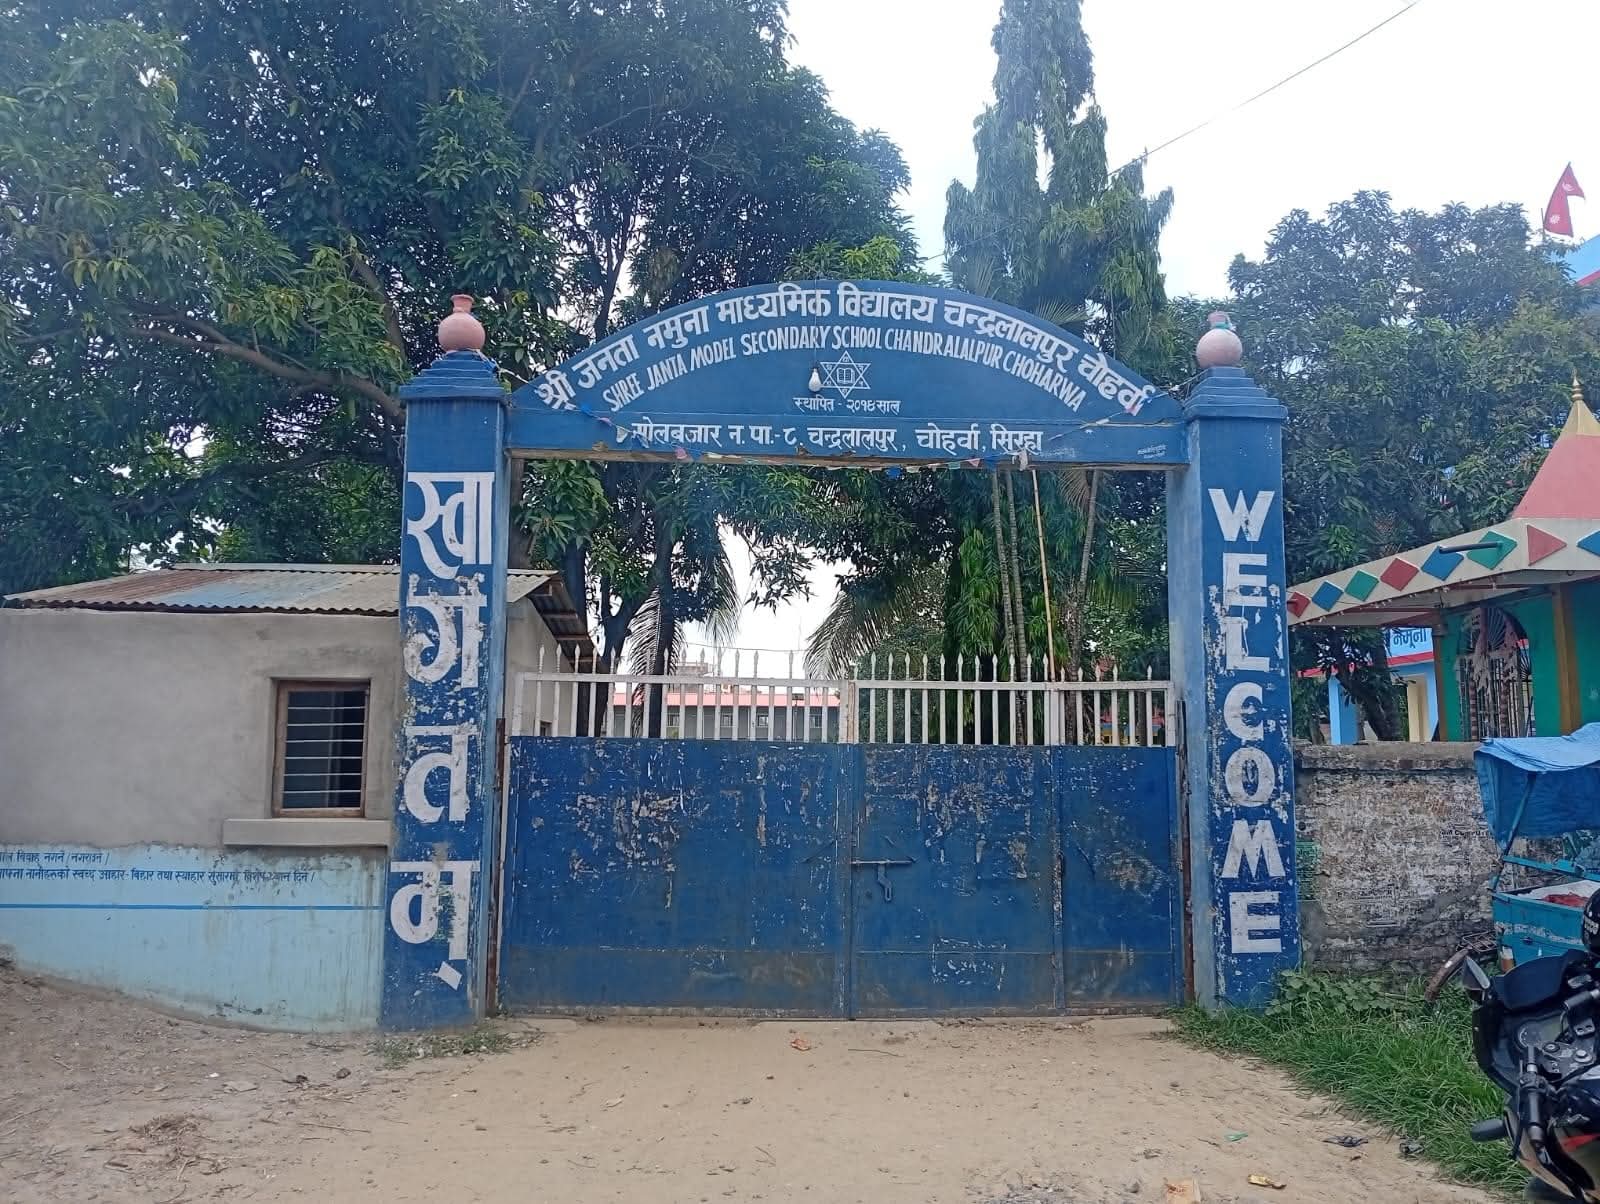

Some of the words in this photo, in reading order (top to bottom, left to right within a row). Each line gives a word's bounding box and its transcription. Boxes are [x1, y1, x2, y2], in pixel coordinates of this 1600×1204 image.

[534, 369, 577, 410] श्री
[572, 334, 641, 389] जनता
[642, 305, 710, 349] नमुना
[715, 282, 832, 325] माध्यमिक
[837, 281, 938, 323] विद्यालय
[944, 299, 1080, 374] चन्द्रलालपुर
[1077, 352, 1157, 417] चोहर्वा
[602, 372, 645, 412] SHREE
[646, 353, 688, 391] JANTA
[690, 337, 736, 371] MODEL
[740, 325, 832, 356] SECONDARY
[831, 325, 882, 350] SCHOOL
[884, 328, 1002, 370] CHANDRALALPUR
[1002, 350, 1088, 413] CHOHARWA
[792, 393, 836, 413] स्थापित
[1207, 488, 1287, 954] WELCOME
